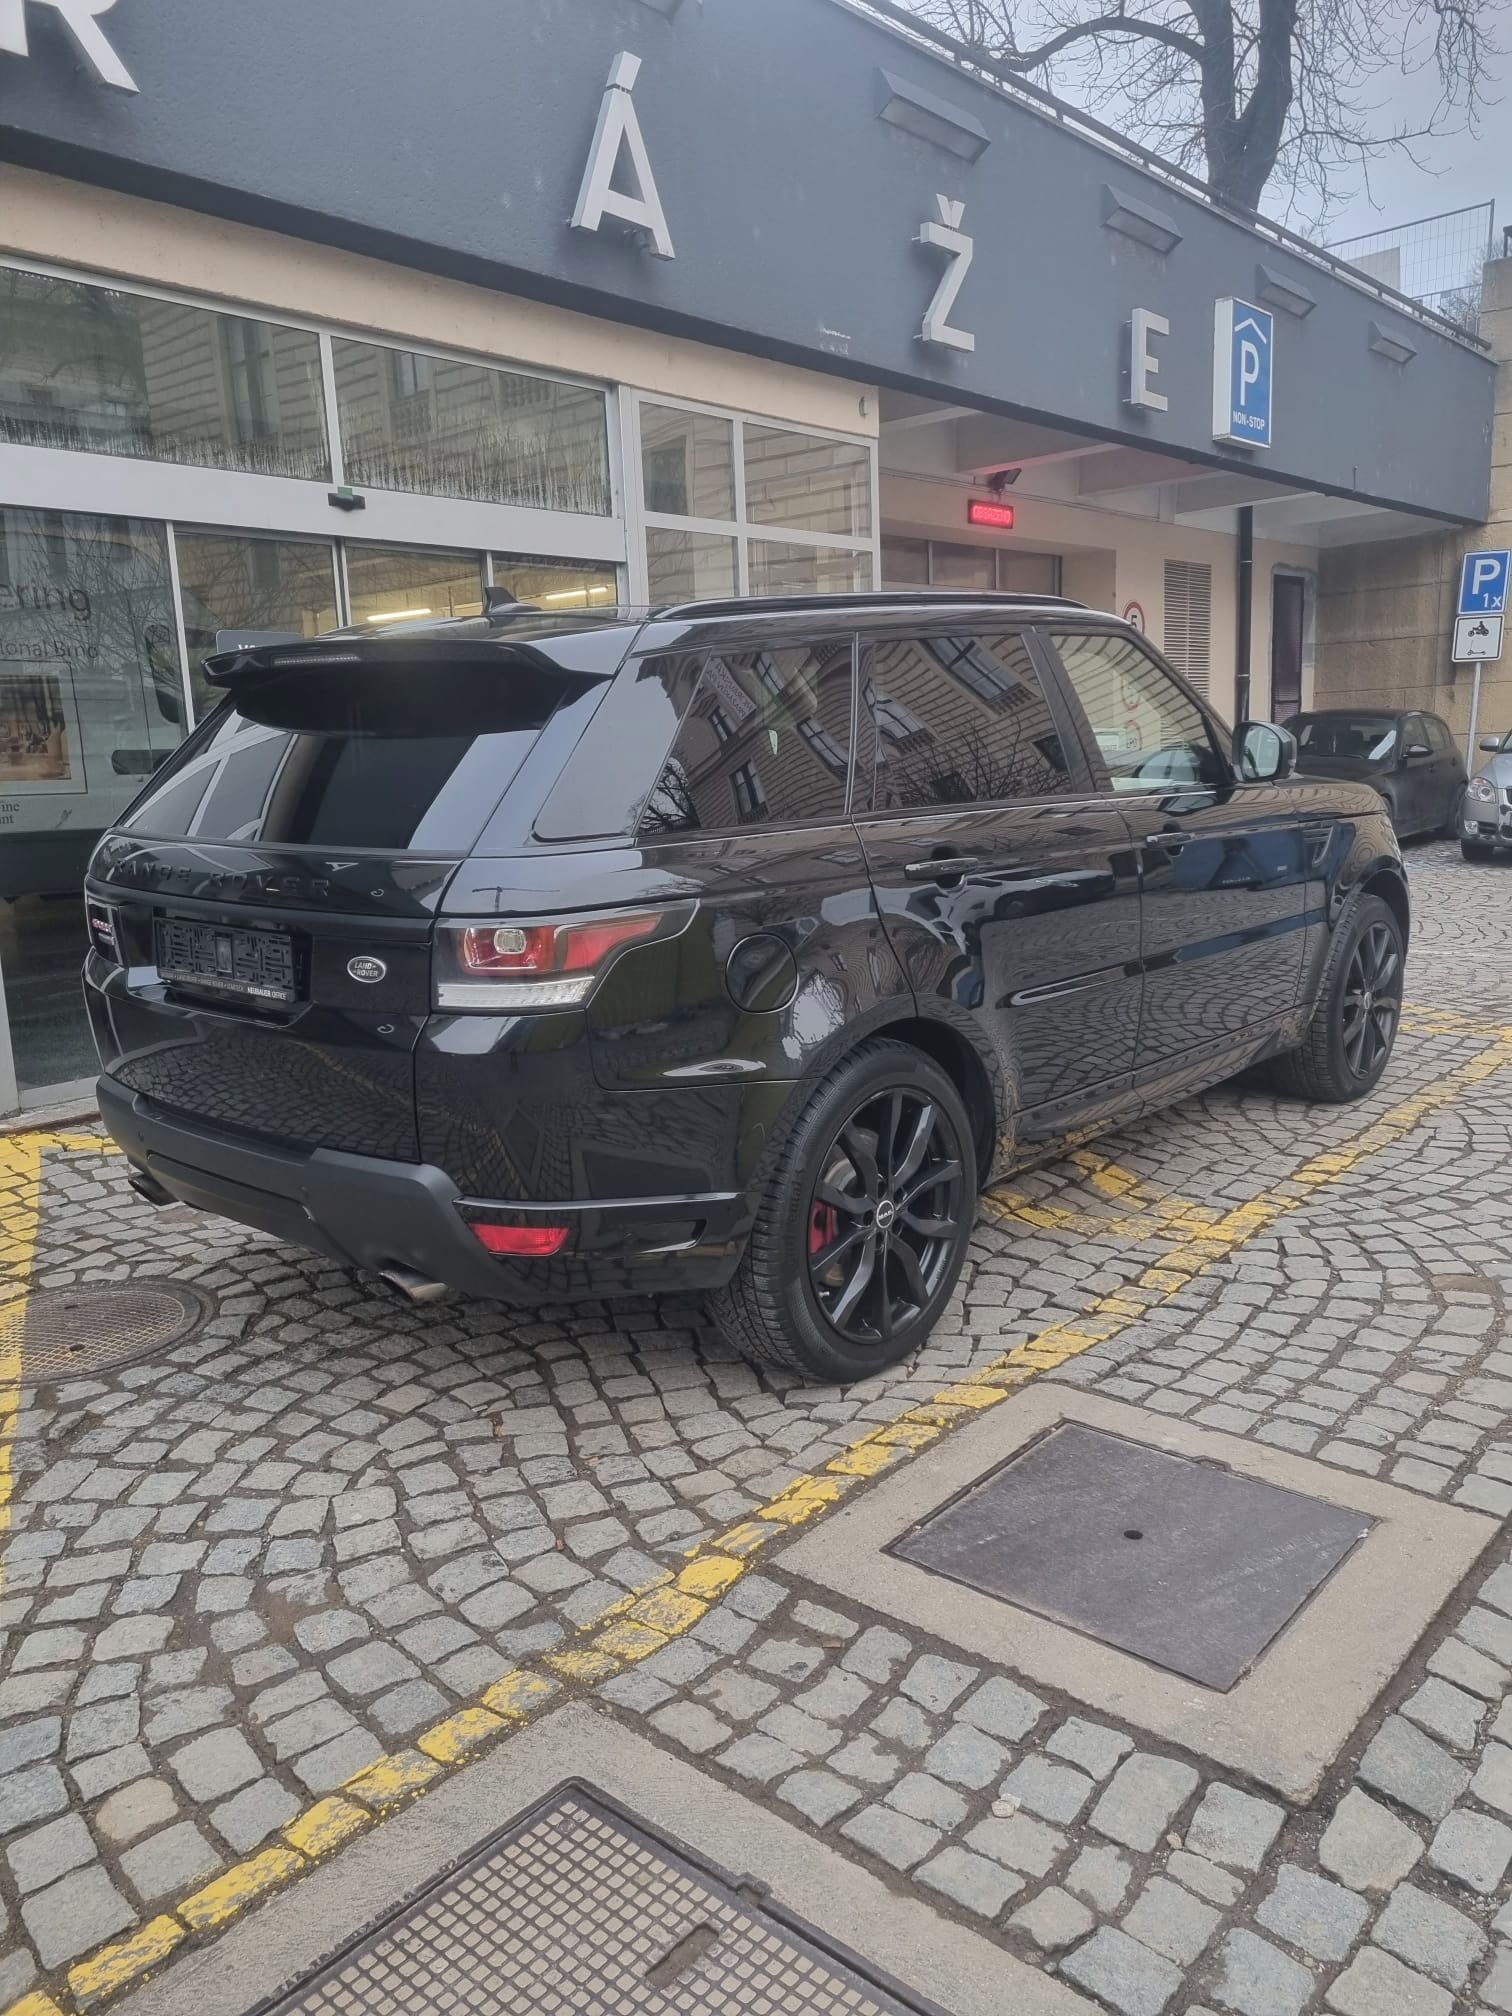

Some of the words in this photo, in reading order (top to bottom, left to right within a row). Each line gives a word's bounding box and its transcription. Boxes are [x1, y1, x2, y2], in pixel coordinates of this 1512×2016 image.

[1240, 339, 1259, 406] P
[1232, 410, 1265, 430] NON-STOP
[1472, 558, 1501, 595] P
[354, 961, 372, 970] LAND
[356, 968, 379, 977] ROVER
